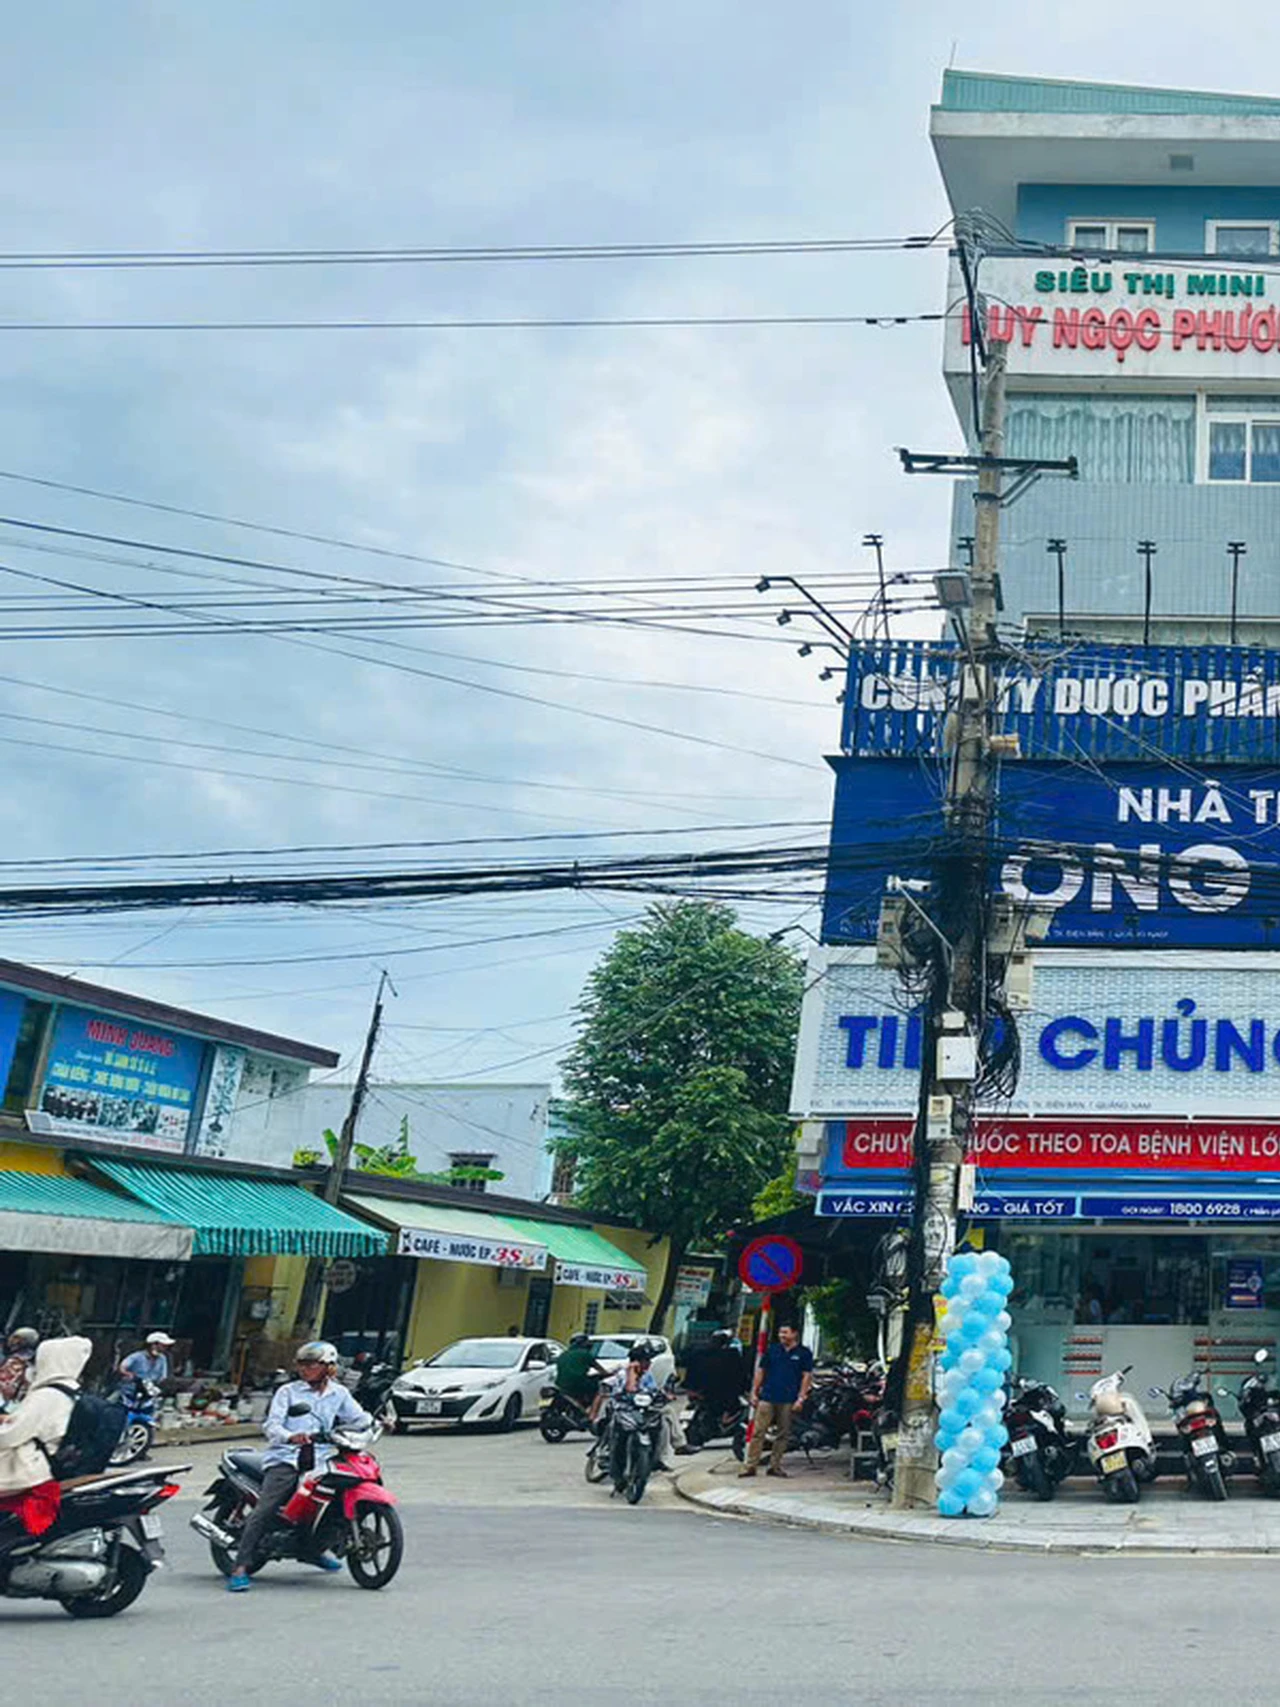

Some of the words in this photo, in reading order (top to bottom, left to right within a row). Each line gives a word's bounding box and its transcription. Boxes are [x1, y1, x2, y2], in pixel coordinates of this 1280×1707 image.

[1035, 267, 1113, 294] SIÊU
[1125, 273, 1175, 299] THỊ
[1187, 274, 1266, 297] MINI
[1053, 307, 1161, 362] NGỌC
[1055, 672, 1168, 722] DƯỢC
[1118, 780, 1232, 823] NHÀ
[1002, 843, 1251, 913] ONG
[854, 1132, 912, 1155] CHUY
[1028, 1133, 1083, 1154] THEO
[1090, 1133, 1131, 1155] TOA
[1138, 1130, 1192, 1160] BỆNH
[1198, 1131, 1243, 1162] VIỆN
[868, 1200, 894, 1214] XIN
[1003, 1198, 1031, 1214] GIÁ
[1035, 1197, 1064, 1215] TỐT
[1170, 1202, 1202, 1215] 1800
[1205, 1203, 1241, 1216] 6928
